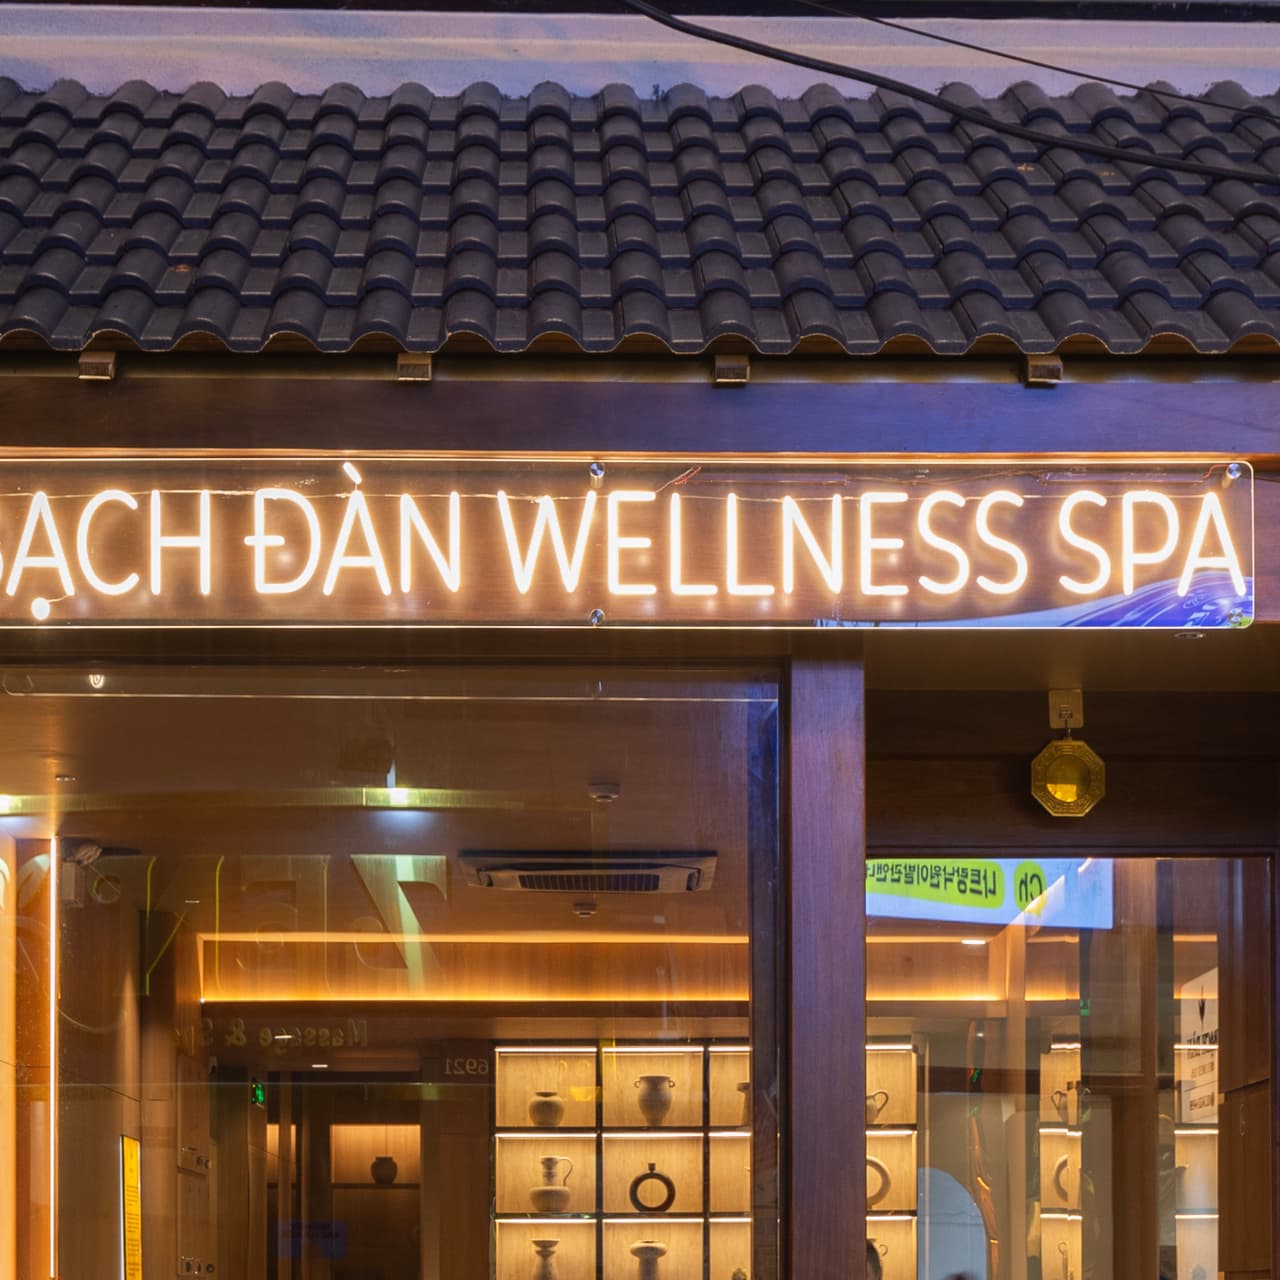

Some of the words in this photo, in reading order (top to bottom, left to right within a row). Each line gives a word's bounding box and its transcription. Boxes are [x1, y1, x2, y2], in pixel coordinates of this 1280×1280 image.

[243, 461, 461, 596] ĐÀN
[496, 490, 1028, 596] WELLNESS
[1057, 490, 1248, 597] SPA
